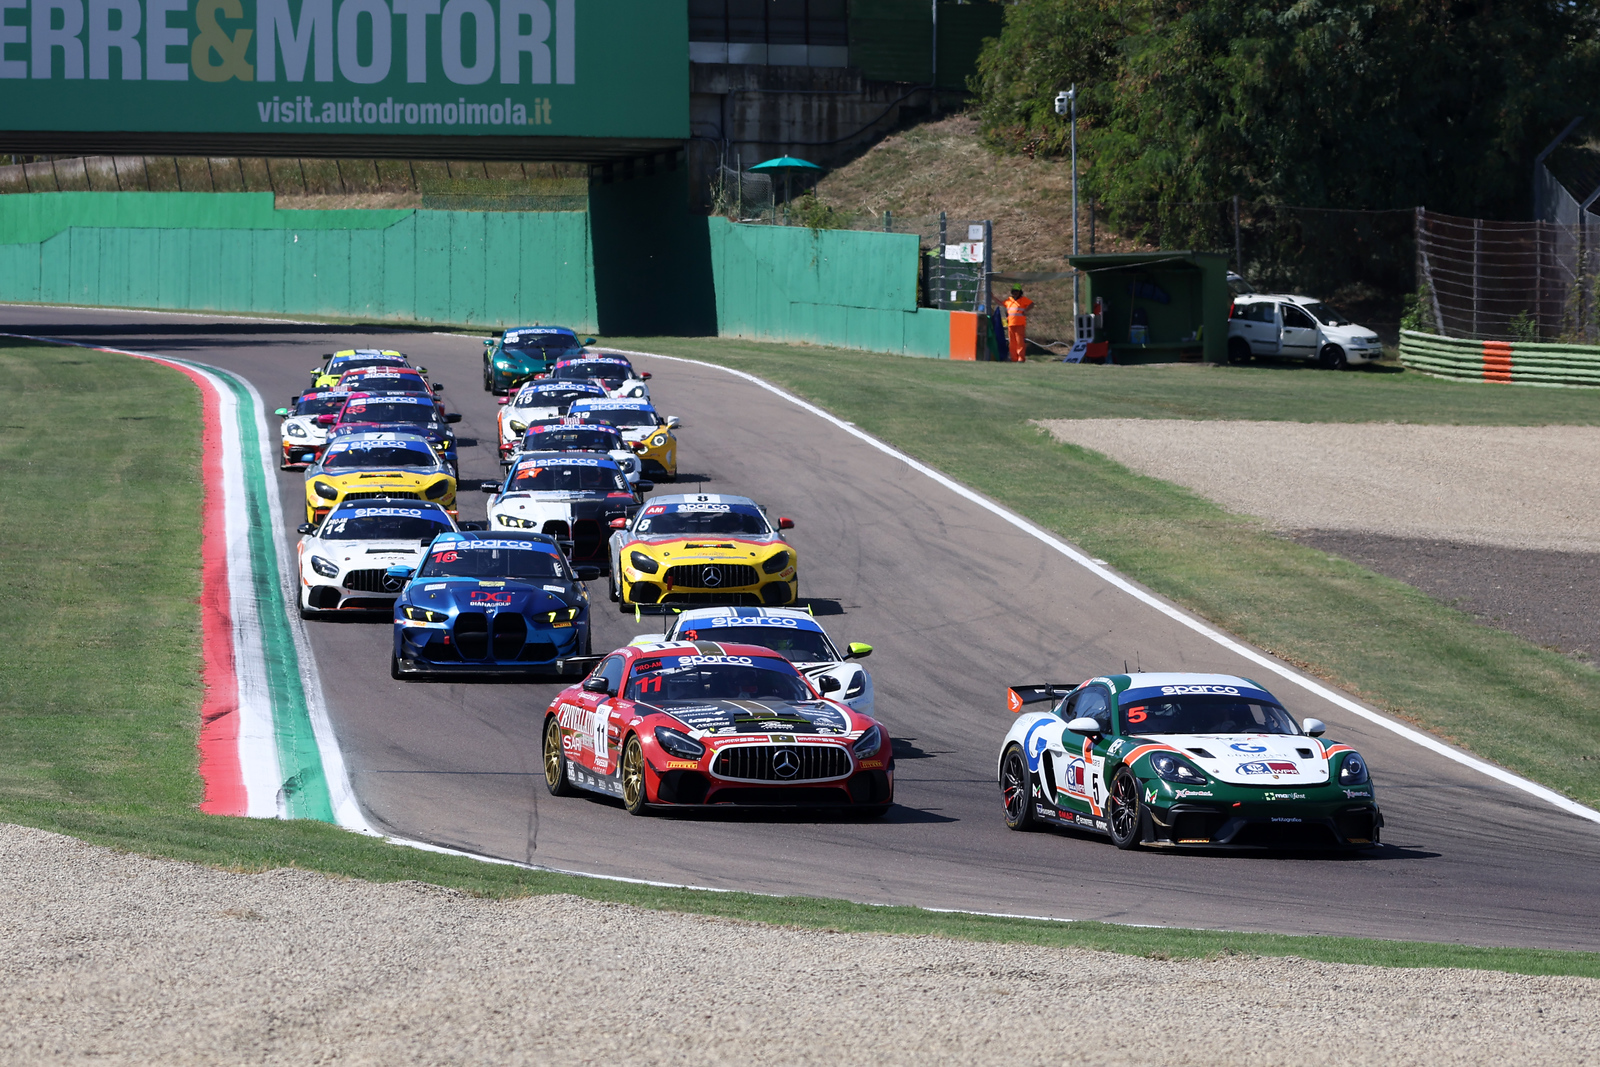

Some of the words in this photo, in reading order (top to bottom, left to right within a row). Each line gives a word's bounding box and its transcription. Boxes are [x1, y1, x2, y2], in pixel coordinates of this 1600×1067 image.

[0, 0, 575, 84] ERRE&MOTORI
[257, 97, 552, 125] visit.autodromoimola.it
[366, 396, 417, 404] sparco
[519, 397, 532, 405] 19
[346, 405, 366, 414] 65
[528, 425, 545, 434] 76
[350, 440, 407, 449] sparco
[325, 454, 337, 465] 7
[536, 458, 598, 467] sparco
[516, 468, 543, 480] 27
[354, 507, 422, 518] sparco
[648, 506, 664, 514] AM
[677, 503, 731, 512] sparco
[325, 523, 345, 534] 14
[637, 519, 651, 532] 8
[457, 540, 533, 550] sparco
[432, 551, 458, 563] 16
[711, 616, 798, 628] sparco
[685, 630, 698, 641] 3
[635, 661, 662, 671] PRO-AM
[678, 655, 753, 666] sparco
[635, 676, 662, 693] 11
[1161, 685, 1241, 696] sparco
[1128, 706, 1148, 723] 5
[596, 723, 605, 753] 11
[1092, 773, 1100, 806] 5
